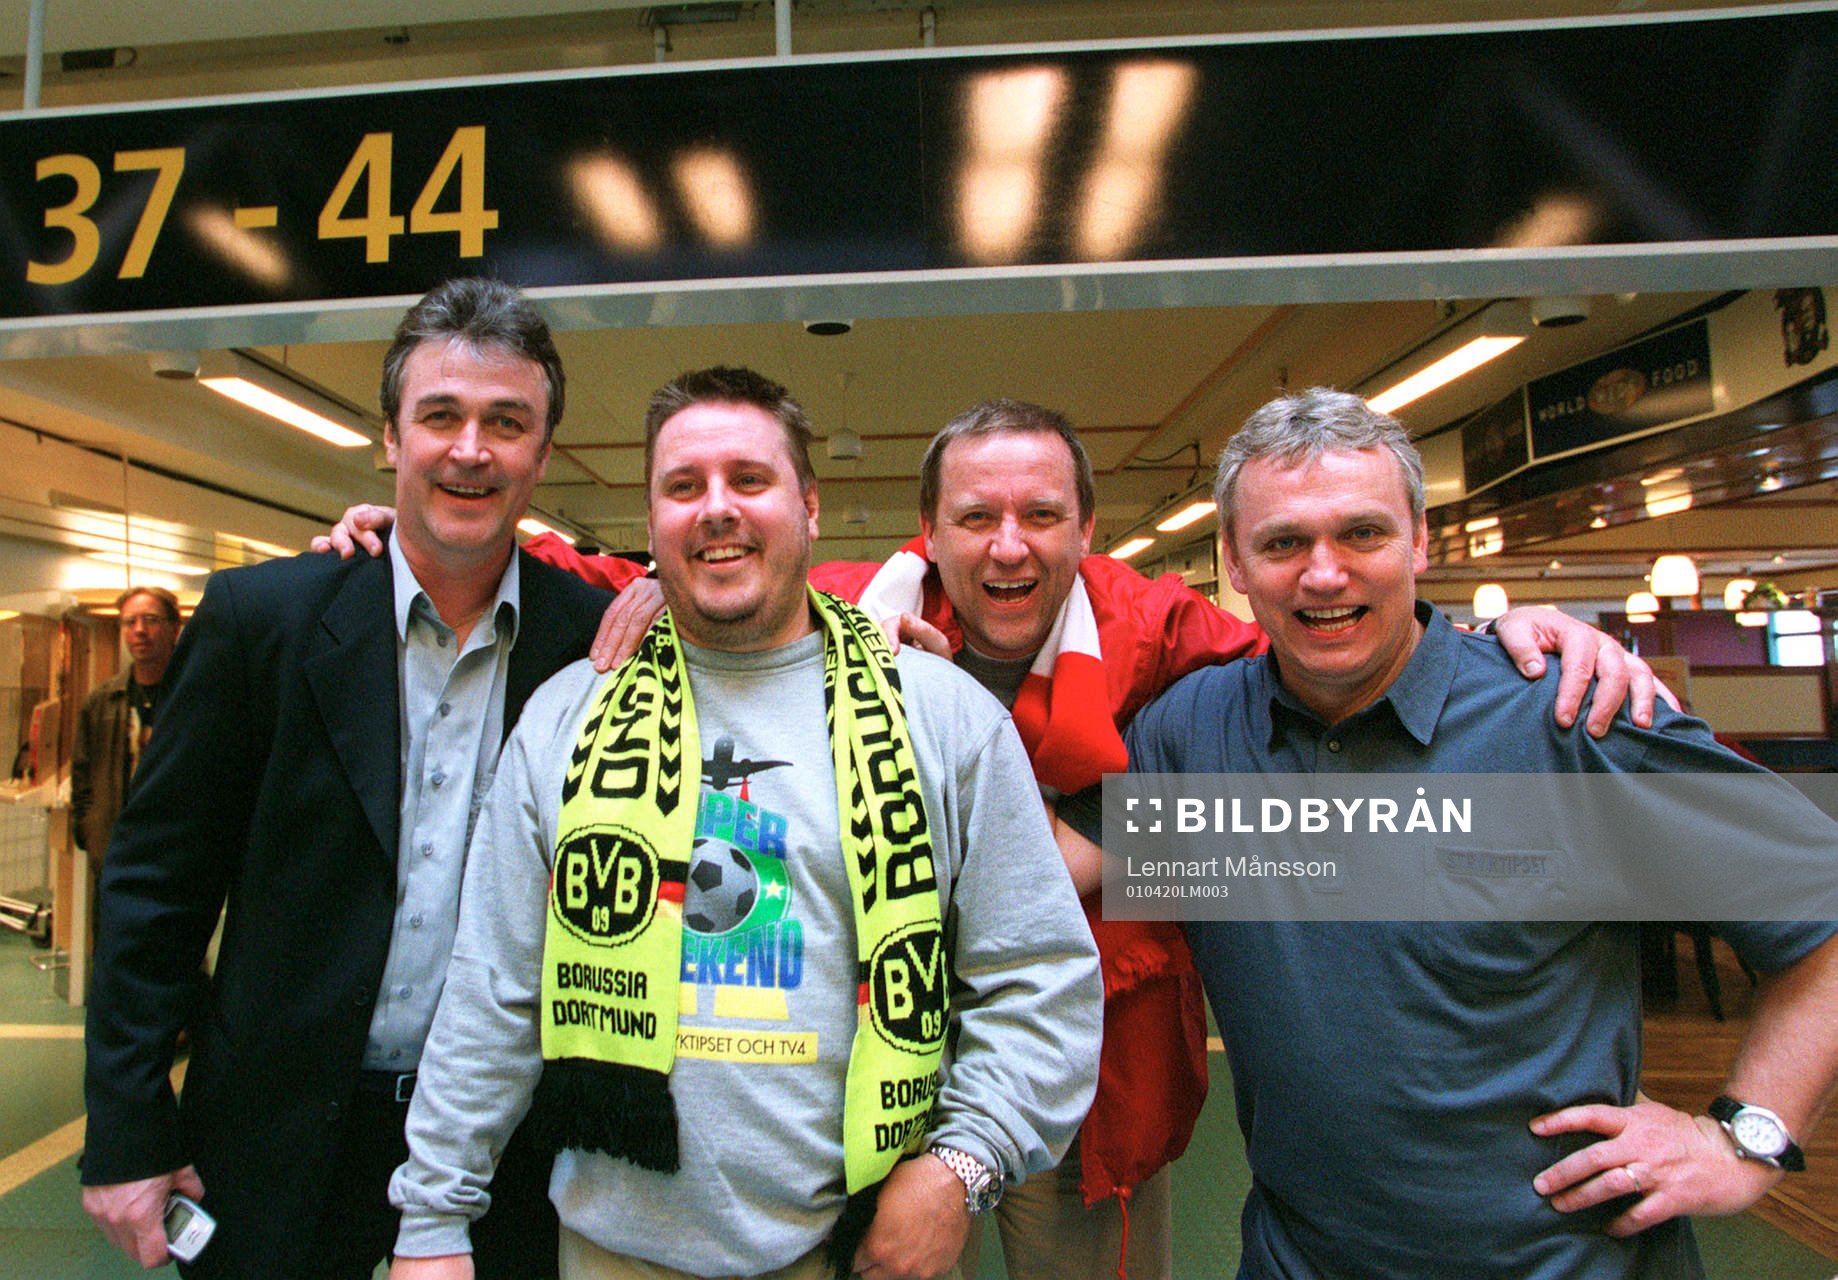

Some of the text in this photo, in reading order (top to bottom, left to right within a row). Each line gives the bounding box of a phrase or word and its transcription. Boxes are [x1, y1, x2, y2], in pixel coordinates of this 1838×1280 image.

[26, 125, 498, 286] 37 - 44
[565, 838, 643, 914] BVB
[591, 906, 610, 932] 09
[557, 963, 648, 999] BORUSSIA
[552, 999, 657, 1040] DORTMUND
[921, 1010, 942, 1039] 09
[737, 1038, 775, 1055] OCH
[780, 1040, 806, 1055] TV4
